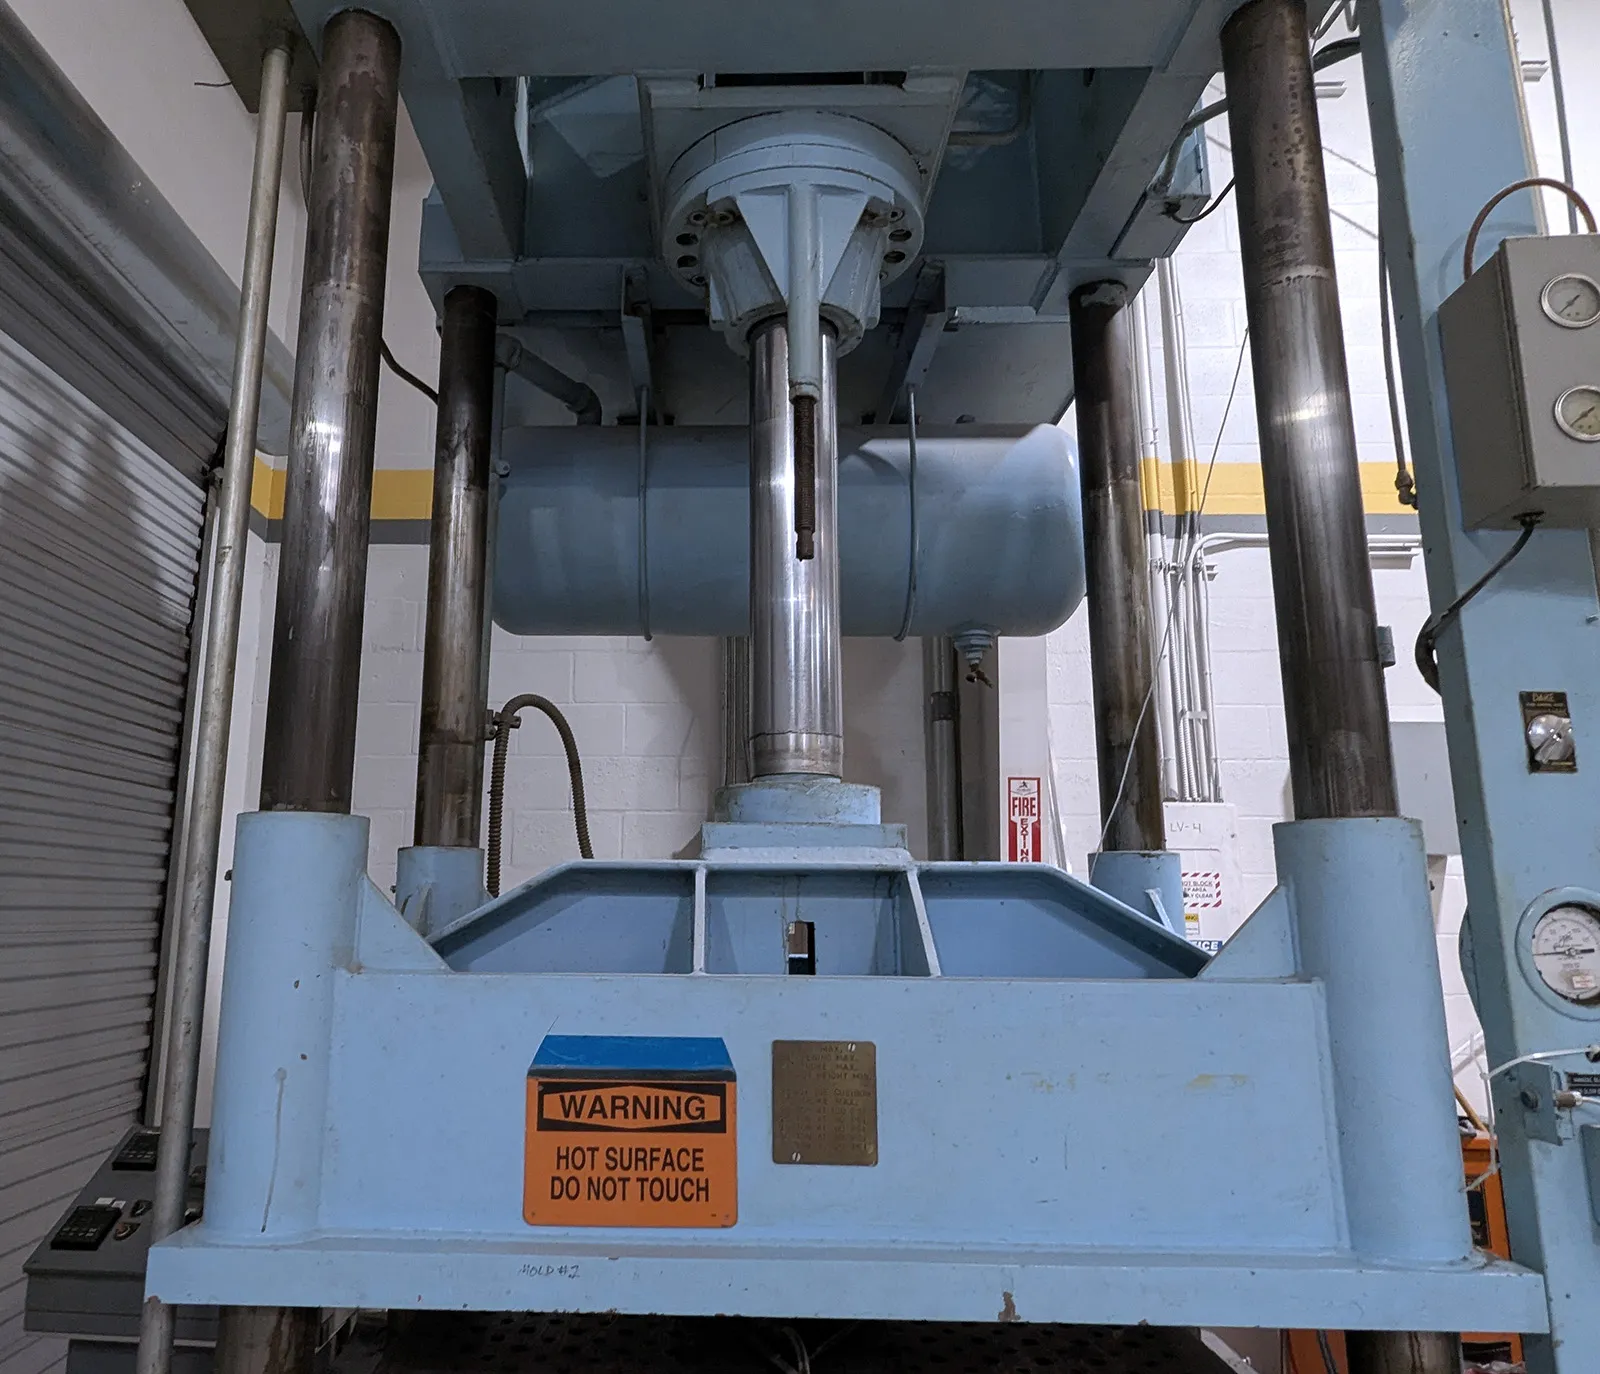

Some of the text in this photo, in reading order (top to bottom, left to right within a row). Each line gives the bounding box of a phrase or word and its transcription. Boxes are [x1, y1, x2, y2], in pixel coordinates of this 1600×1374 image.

[1012, 796, 1036, 816] FIRE
[1192, 880, 1213, 888] BLOCK
[559, 1094, 706, 1121] WARNING
[556, 1146, 705, 1172] HOT SURFACE
[551, 1176, 709, 1202] DO NOT TOUCH
